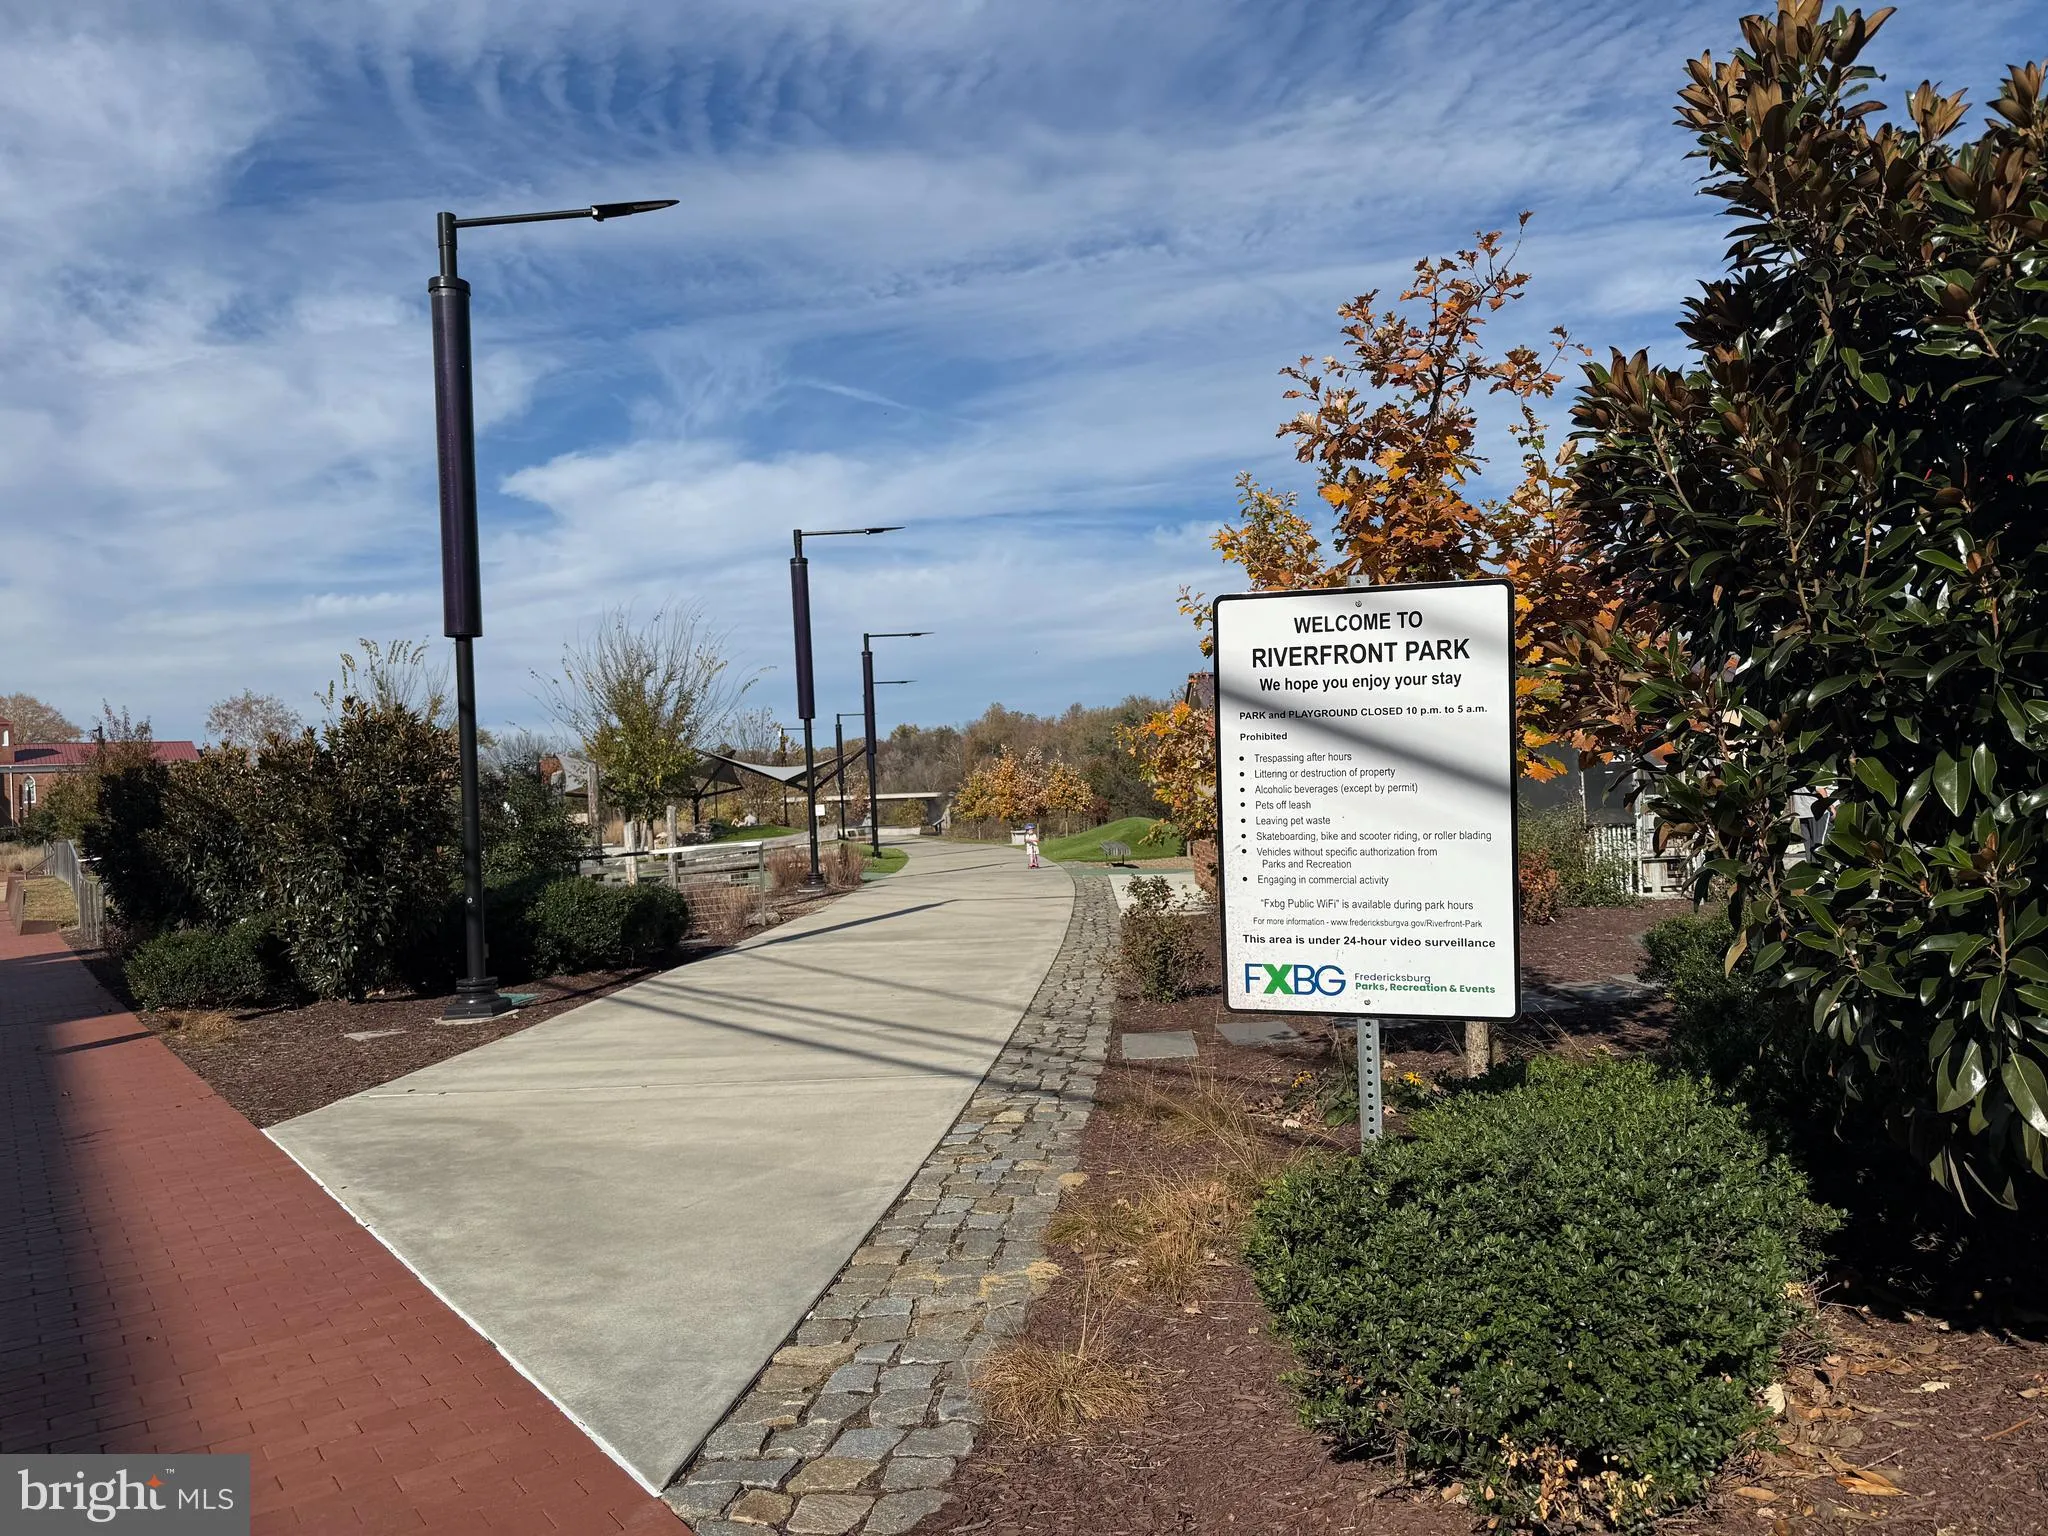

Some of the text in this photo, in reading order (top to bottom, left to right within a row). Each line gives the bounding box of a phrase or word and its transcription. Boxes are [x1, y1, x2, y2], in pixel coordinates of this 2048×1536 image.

[1294, 611, 1423, 634] WELCOME TO
[1252, 638, 1470, 668] RIVERFRONT PARK
[1260, 671, 1461, 692] We hope you enjoy your stay
[1239, 705, 1487, 720] PARK and PLAYGROUND CLOSED 10 p.m. to 5 a.m.
[1240, 732, 1288, 741] Prohibited
[1254, 753, 1352, 764] Trespassing after hours
[1254, 768, 1396, 780] Littering or destruction of property
[1254, 783, 1418, 795] Alcoholic beverages (except by permit)
[1255, 801, 1311, 810] Pets off leash
[1256, 816, 1331, 827] Leaving pet waste
[1256, 831, 1492, 842] Skateboarding, bike and scooter riding, or roller blading
[1257, 847, 1437, 858] Vehicles without specific authorization from
[1262, 859, 1351, 869] Parks and Recreation
[1257, 875, 1389, 886] Engaging in commercial activity
[1260, 898, 1474, 911] "Fxbg Public WiFi" is available during park hours
[1253, 917, 1265, 925] For
[1286, 917, 1325, 926] information
[1331, 918, 1482, 929] www.fredericksburgva.gov/Riverfront-Park
[1242, 934, 1496, 948] This area is under 24-hour video surveillance
[1244, 963, 1346, 996] FXBG
[1354, 972, 1431, 985] Fredericksburg
[1355, 982, 1496, 994] Parks, Recreation & Events
